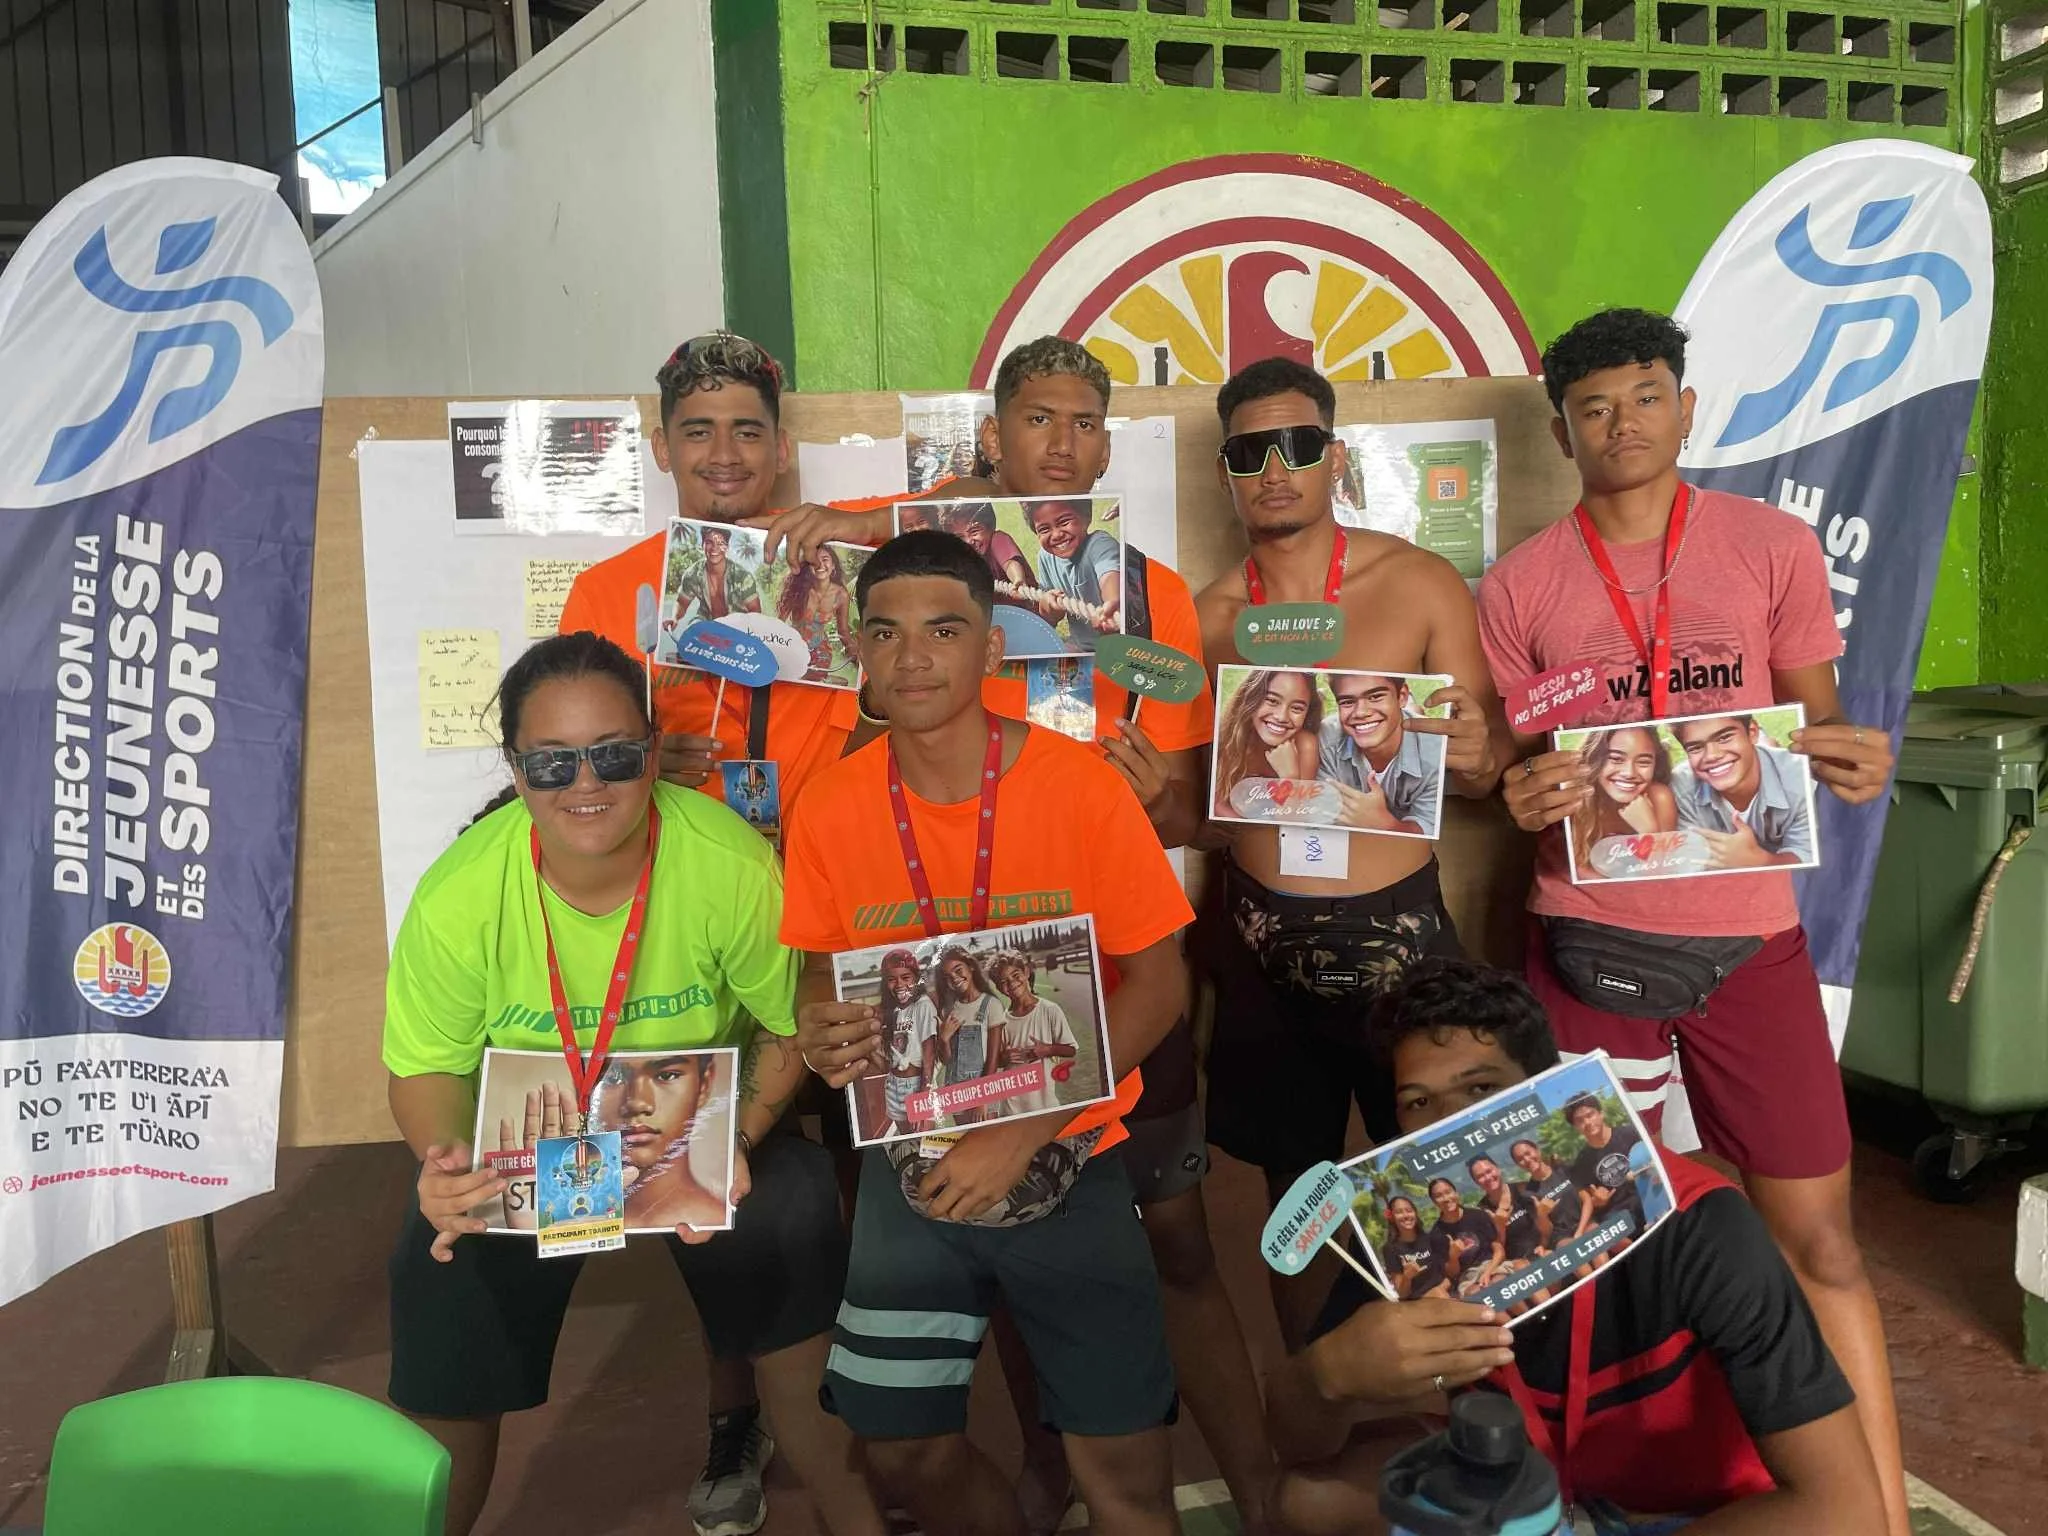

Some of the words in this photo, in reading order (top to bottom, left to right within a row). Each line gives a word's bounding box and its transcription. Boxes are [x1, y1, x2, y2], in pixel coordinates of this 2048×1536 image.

[456, 426, 497, 443] Pourquoi
[1153, 423, 1167, 438] 2
[74, 534, 100, 573] LA
[71, 575, 97, 617] DE
[1267, 618, 1290, 631] JAH
[1292, 617, 1321, 631] LOVE
[712, 654, 739, 668] sans
[1606, 653, 1744, 702] wZaland
[159, 548, 224, 855] SPORTS
[1514, 709, 1530, 725] NO
[1532, 700, 1550, 718] ICE
[1552, 688, 1574, 708] FOR
[1528, 674, 1566, 703] WESH
[104, 513, 164, 908] JEUNESSE
[53, 622, 95, 895] DIRECTION
[155, 875, 180, 915] ET
[181, 863, 207, 920] DES
[983, 1075, 1017, 1096] CONTRE
[1017, 1070, 1040, 1087] L'ICE
[19, 1096, 63, 1120] NO
[78, 1091, 117, 1112] TE
[31, 1131, 50, 1152] E
[65, 1123, 104, 1145] TE
[1412, 1141, 1461, 1171] L'ICE
[1464, 1129, 1487, 1147] TE
[1490, 1104, 1541, 1136] PIÈGE
[28, 1163, 229, 1192] jeunesseetsport.com
[491, 1155, 519, 1170] NOTRE
[520, 1152, 536, 1169] GÉN
[509, 1180, 537, 1211] ST
[1268, 1241, 1282, 1259] JE
[1276, 1220, 1299, 1247] GÈRE
[1293, 1206, 1310, 1226] MA
[1304, 1167, 1340, 1212] FOUGÈRE
[542, 1229, 588, 1240] PARTICIPANT
[1295, 1218, 1323, 1254] SANS
[1319, 1199, 1338, 1223] ICE
[1483, 1296, 1496, 1308] E
[1500, 1268, 1545, 1300] SPORT
[1550, 1254, 1573, 1271] TE
[1576, 1219, 1629, 1257] LIBÈRE
